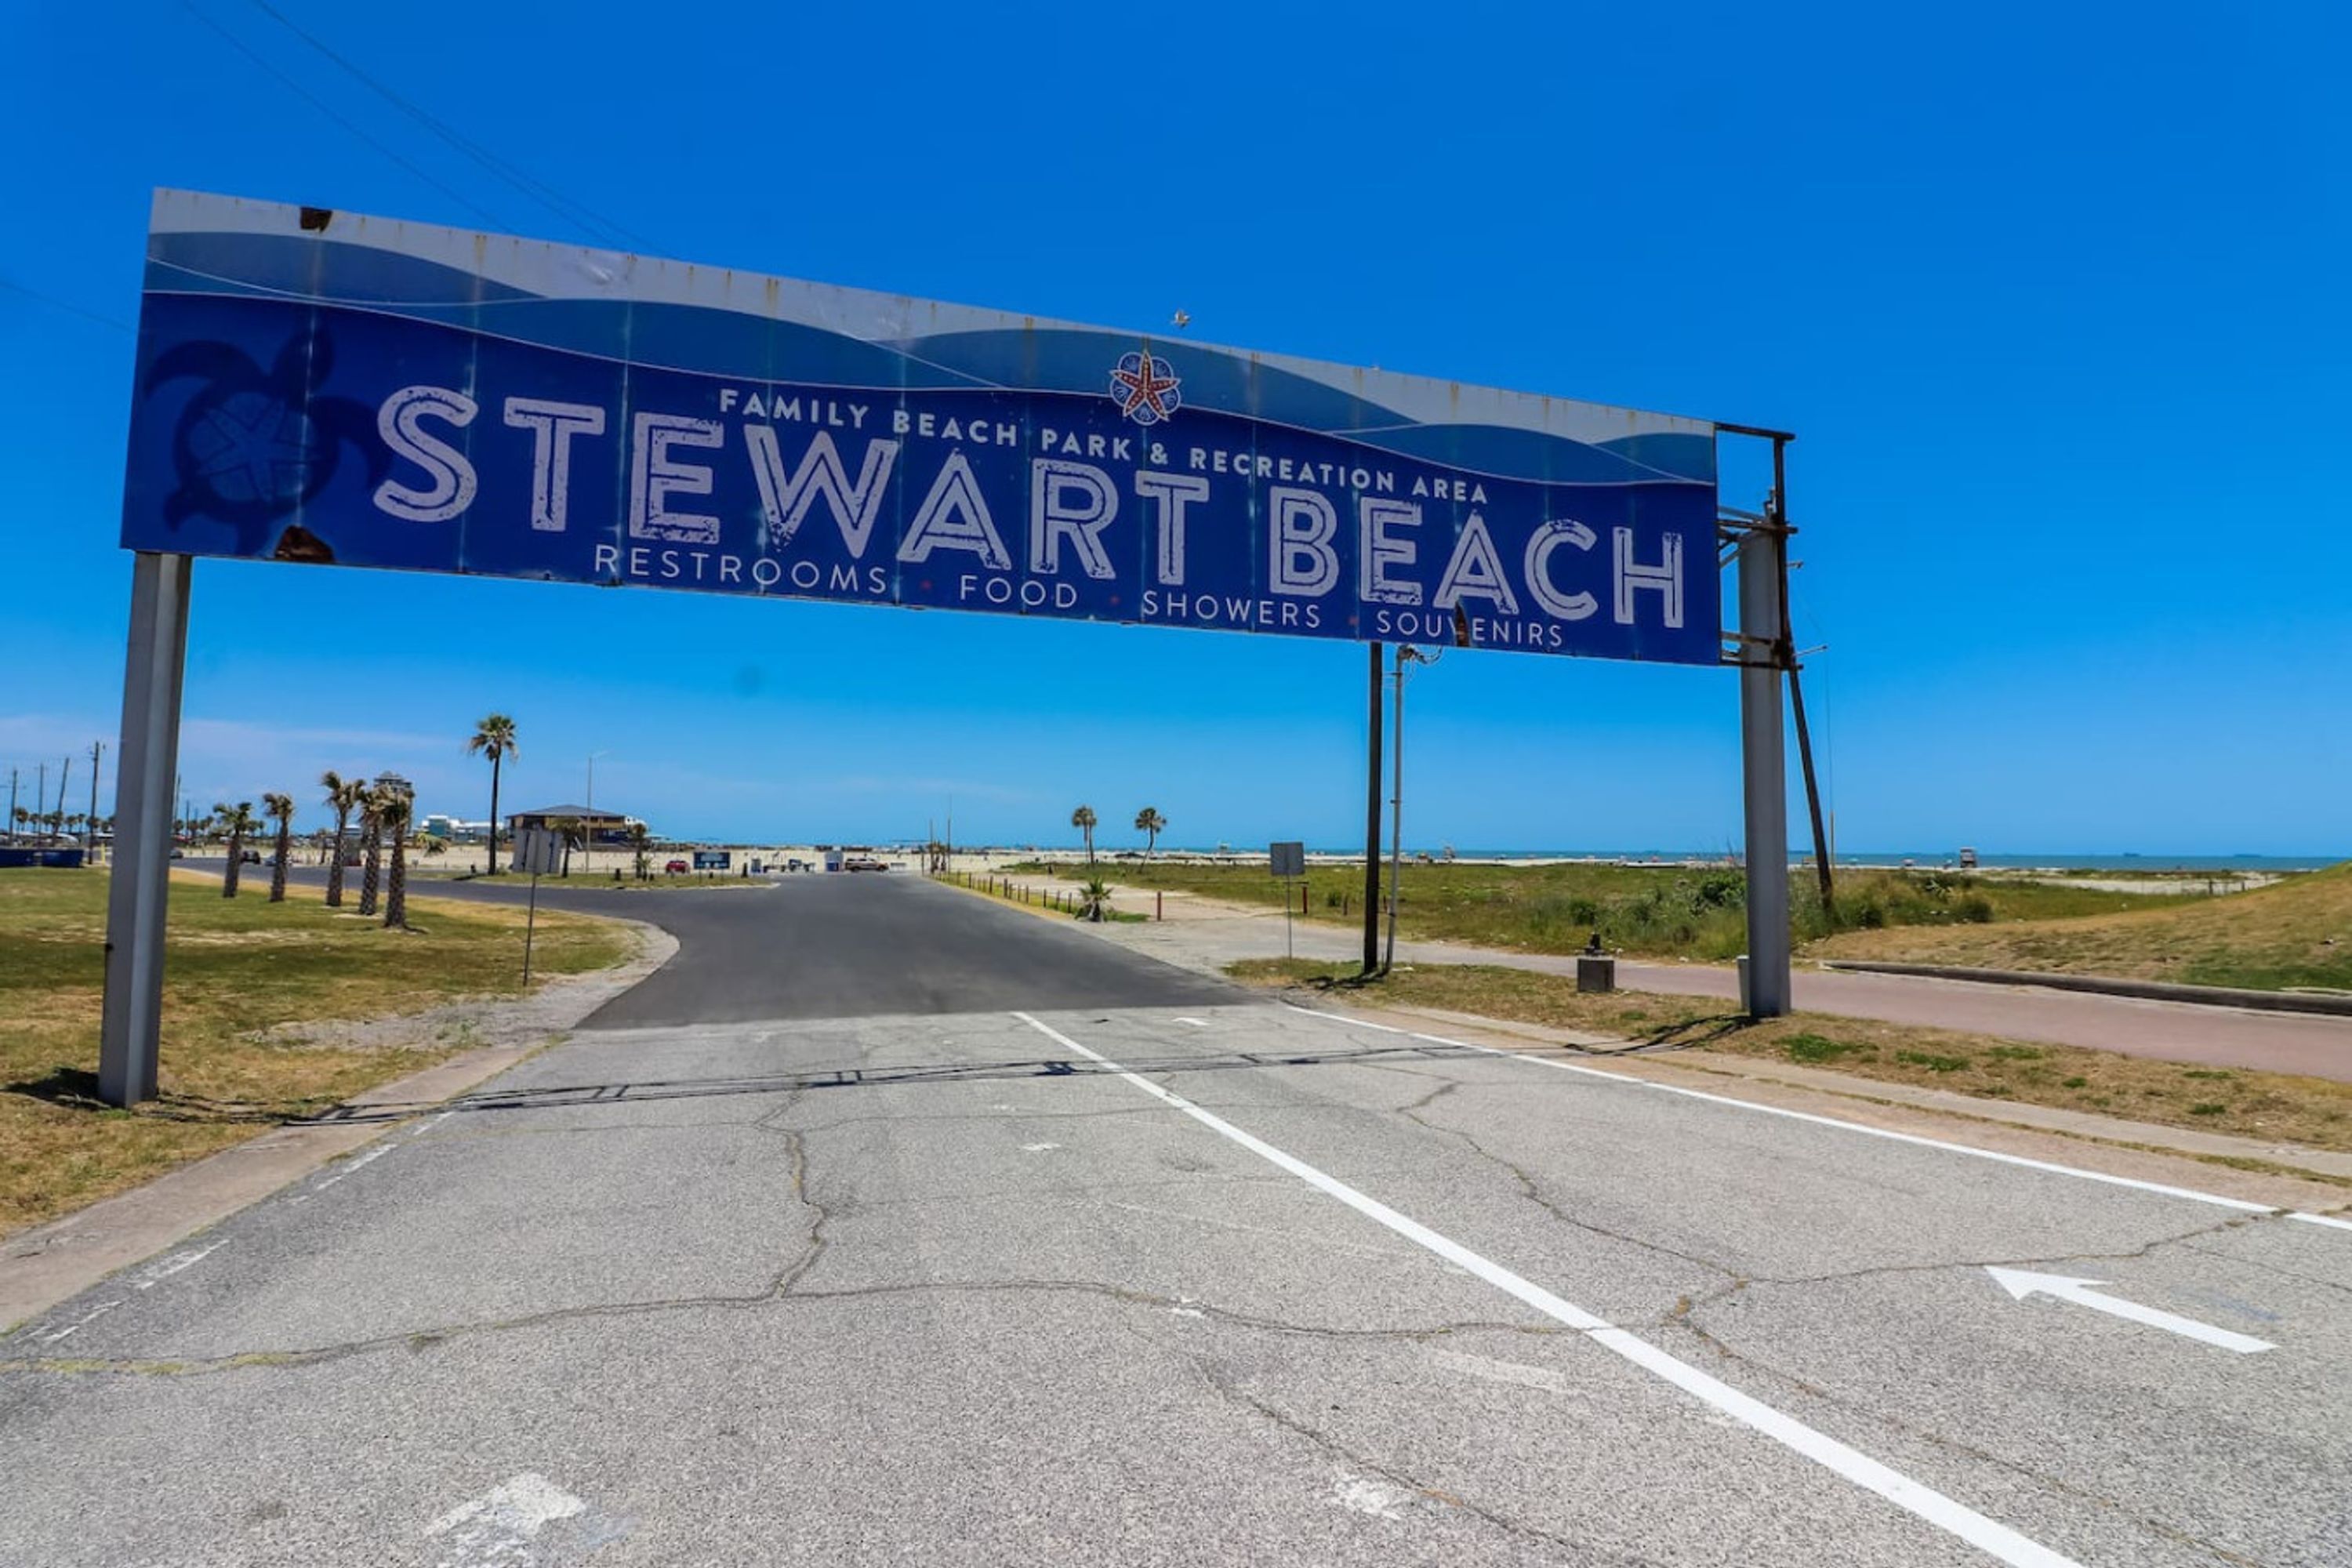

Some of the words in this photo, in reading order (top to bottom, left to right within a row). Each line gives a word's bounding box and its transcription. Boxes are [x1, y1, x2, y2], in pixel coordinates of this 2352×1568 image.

[720, 389, 868, 428] FAMILY
[893, 410, 1017, 446] BEACH
[1041, 429, 1131, 461] PARK
[1149, 443, 1168, 465] &
[1190, 448, 1394, 492] RECREATION
[1412, 477, 1487, 504] AREA
[372, 385, 1210, 586] STEWART
[1269, 486, 1683, 628] BEACH
[595, 544, 886, 594] RESTROOMS
[960, 575, 1077, 608] FOOD
[1143, 590, 1320, 628] SHOWERS
